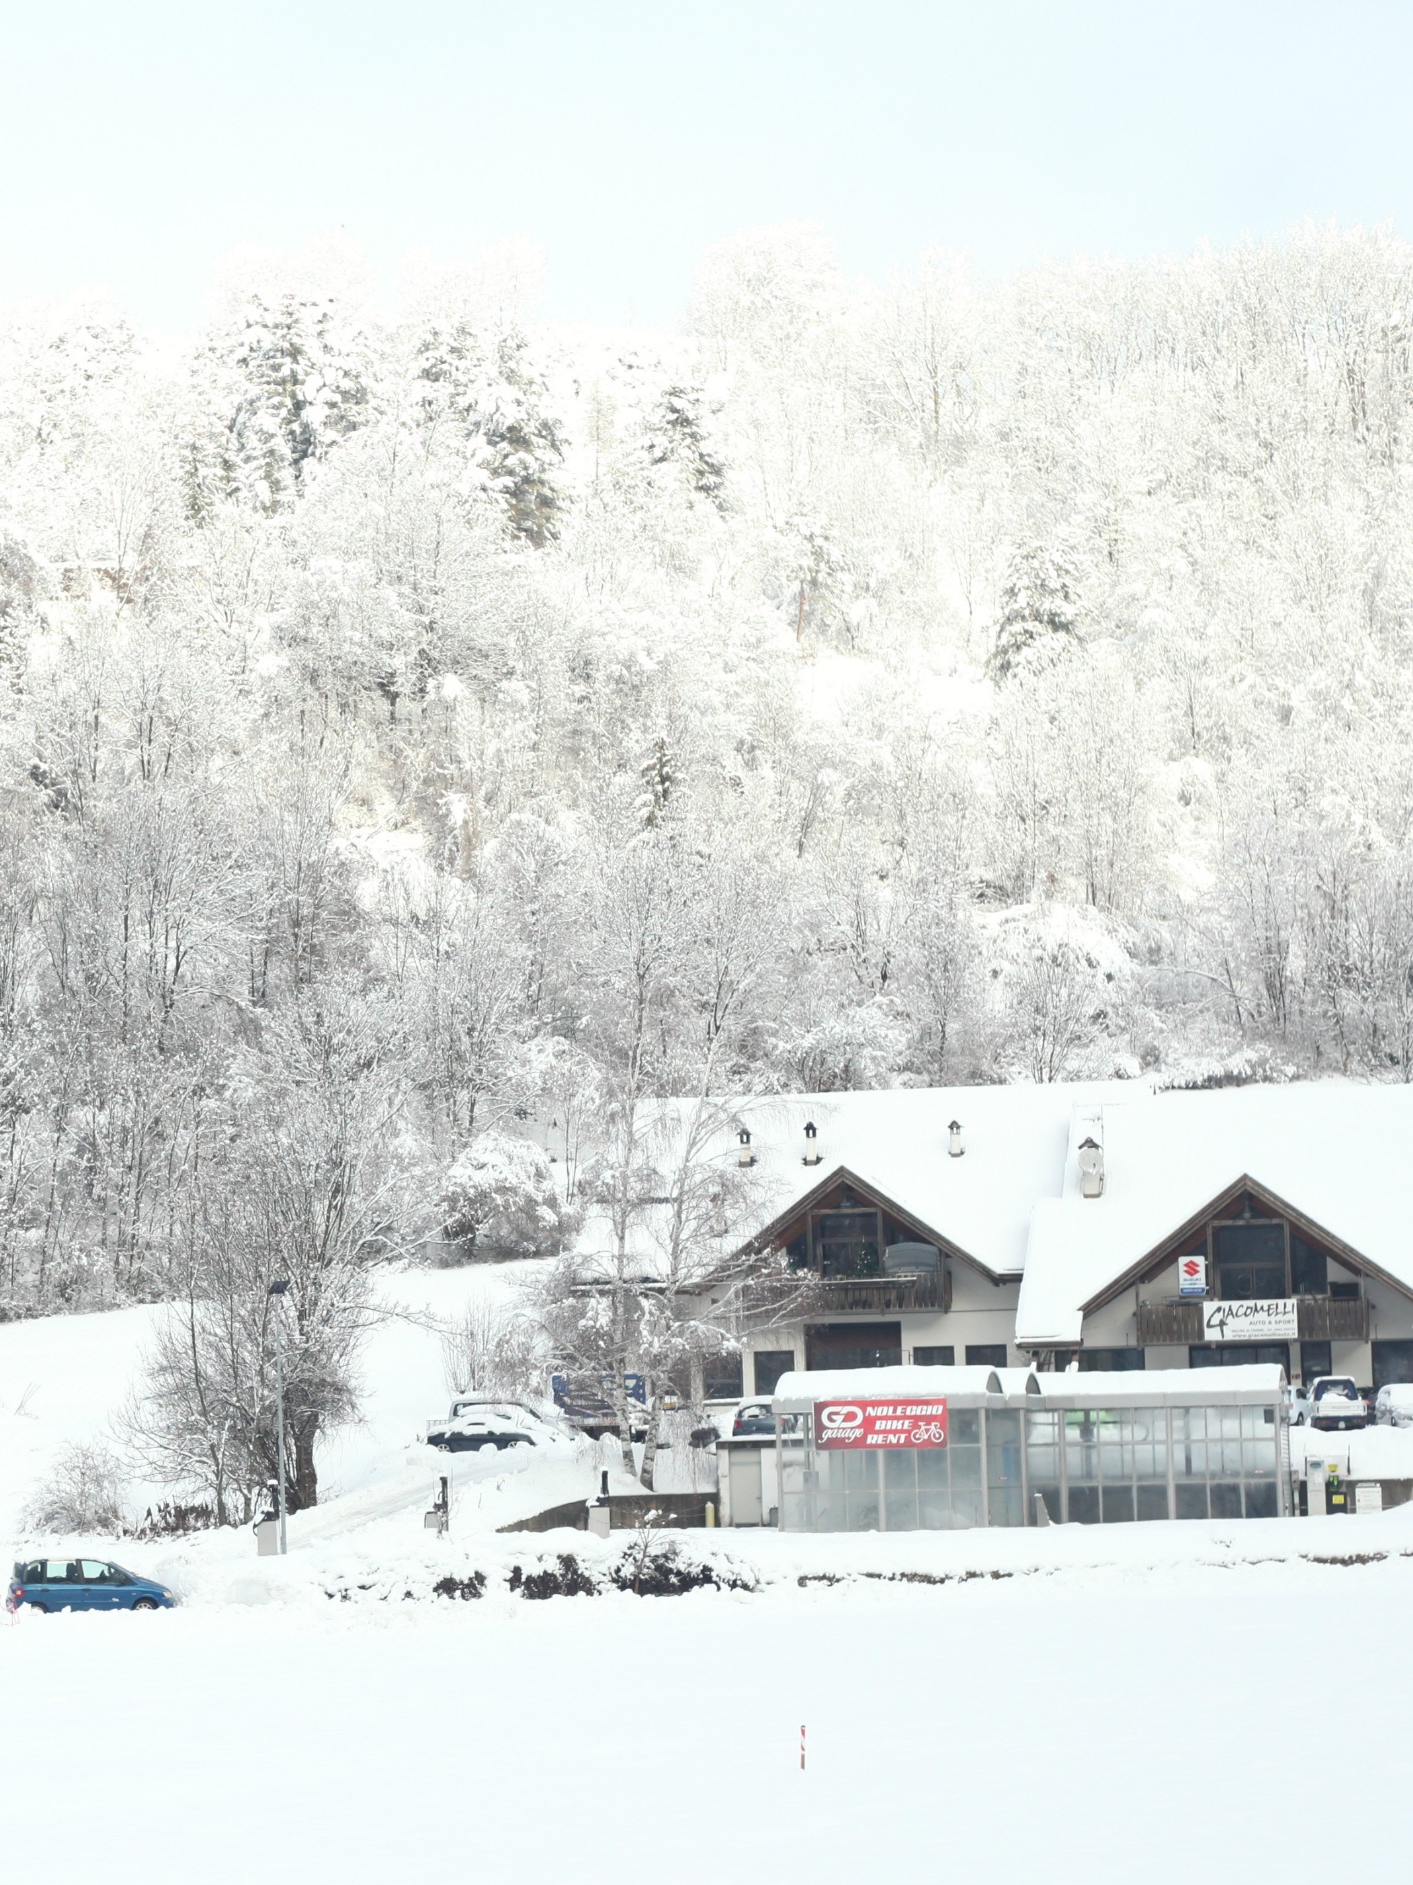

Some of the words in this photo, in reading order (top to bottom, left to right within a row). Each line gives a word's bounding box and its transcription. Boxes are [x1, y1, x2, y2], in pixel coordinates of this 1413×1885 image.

[1206, 1302, 1295, 1339] GIACOMELLI
[865, 1405, 944, 1416] NOLEGGIO
[874, 1420, 914, 1430] BIKE
[818, 1428, 864, 1443] garage
[866, 1434, 908, 1444] RENT
